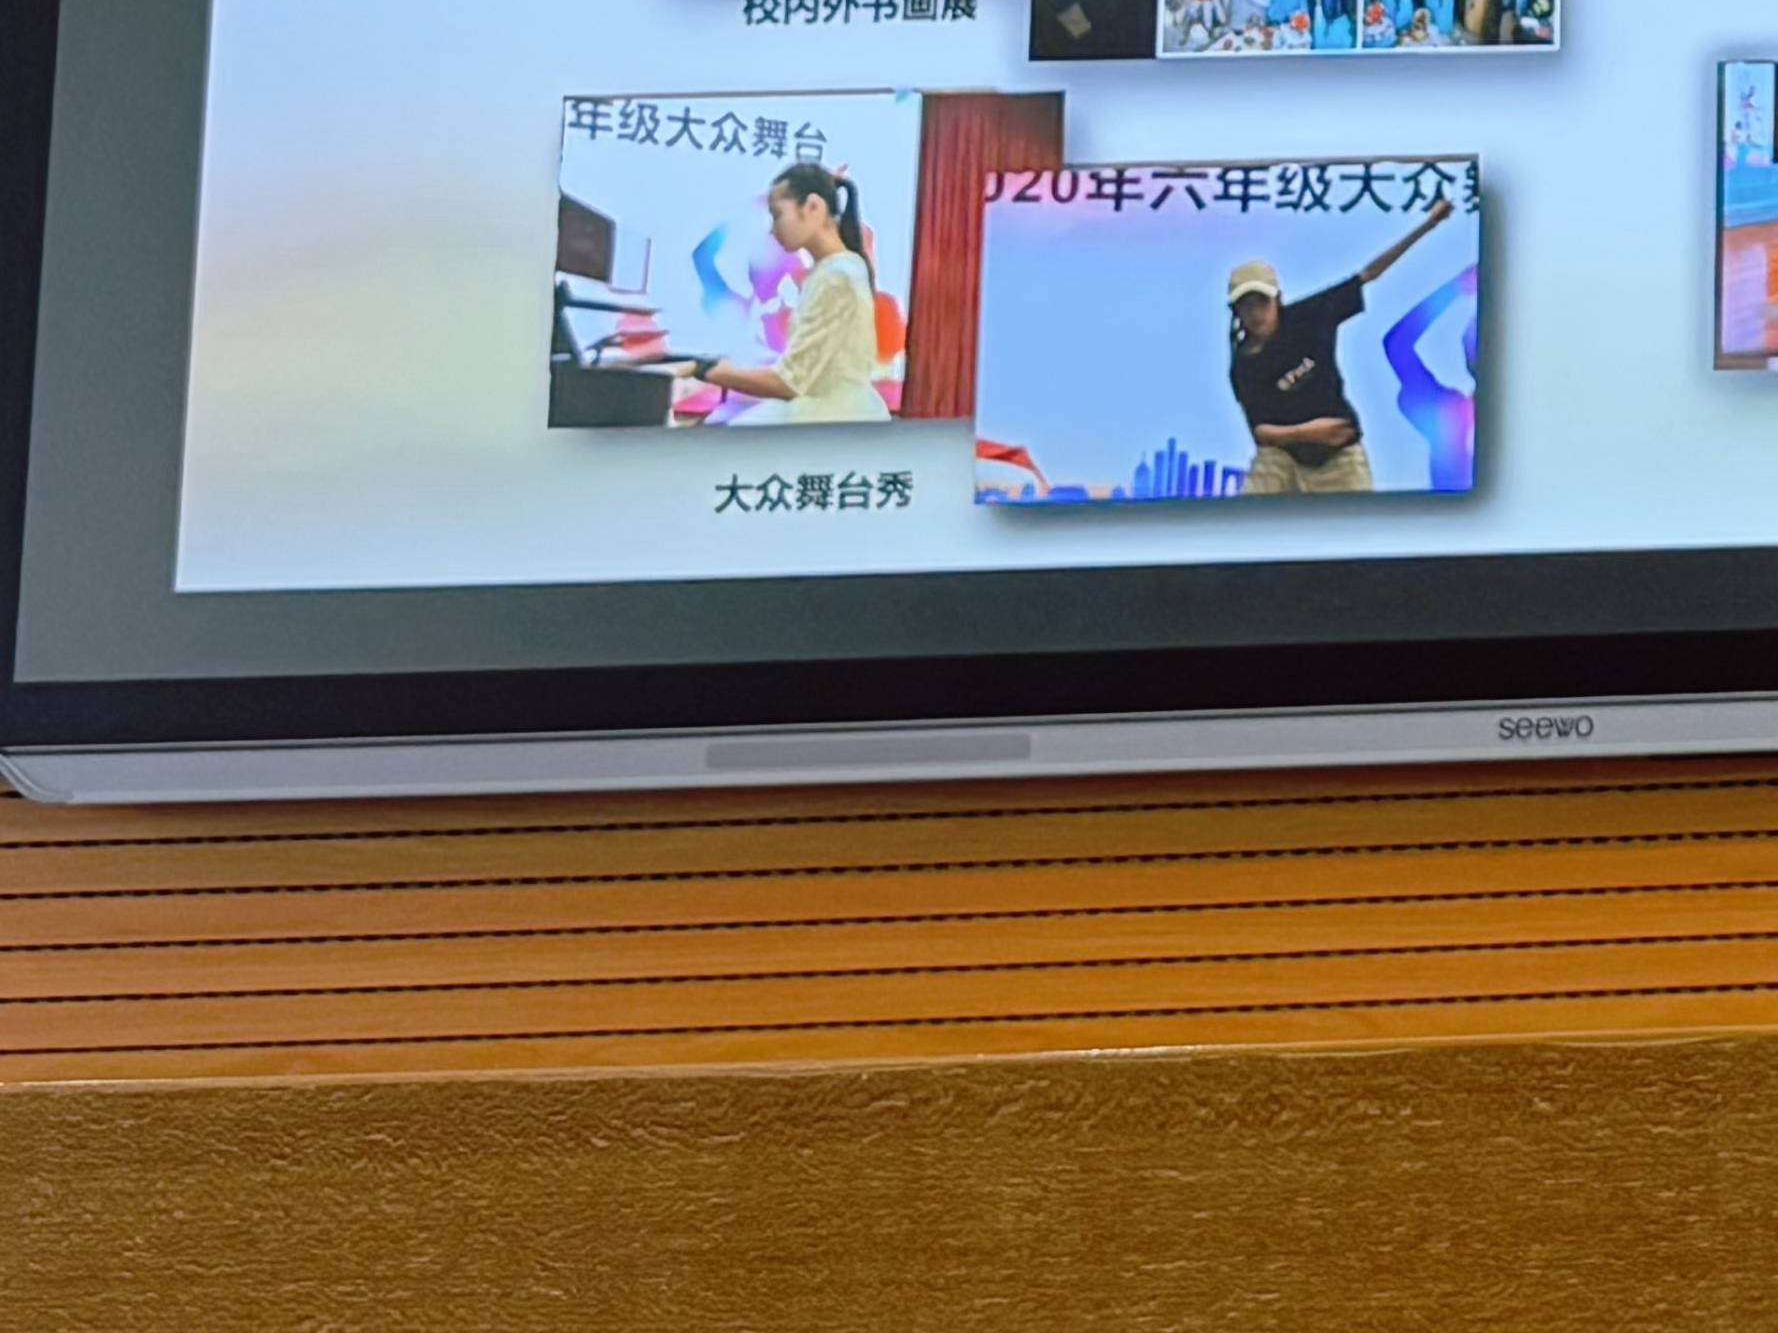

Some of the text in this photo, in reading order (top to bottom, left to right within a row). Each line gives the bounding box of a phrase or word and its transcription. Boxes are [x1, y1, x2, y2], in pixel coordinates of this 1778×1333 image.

[714, 470, 913, 513] 大众舞台秀
[1499, 715, 1594, 740] seewo
